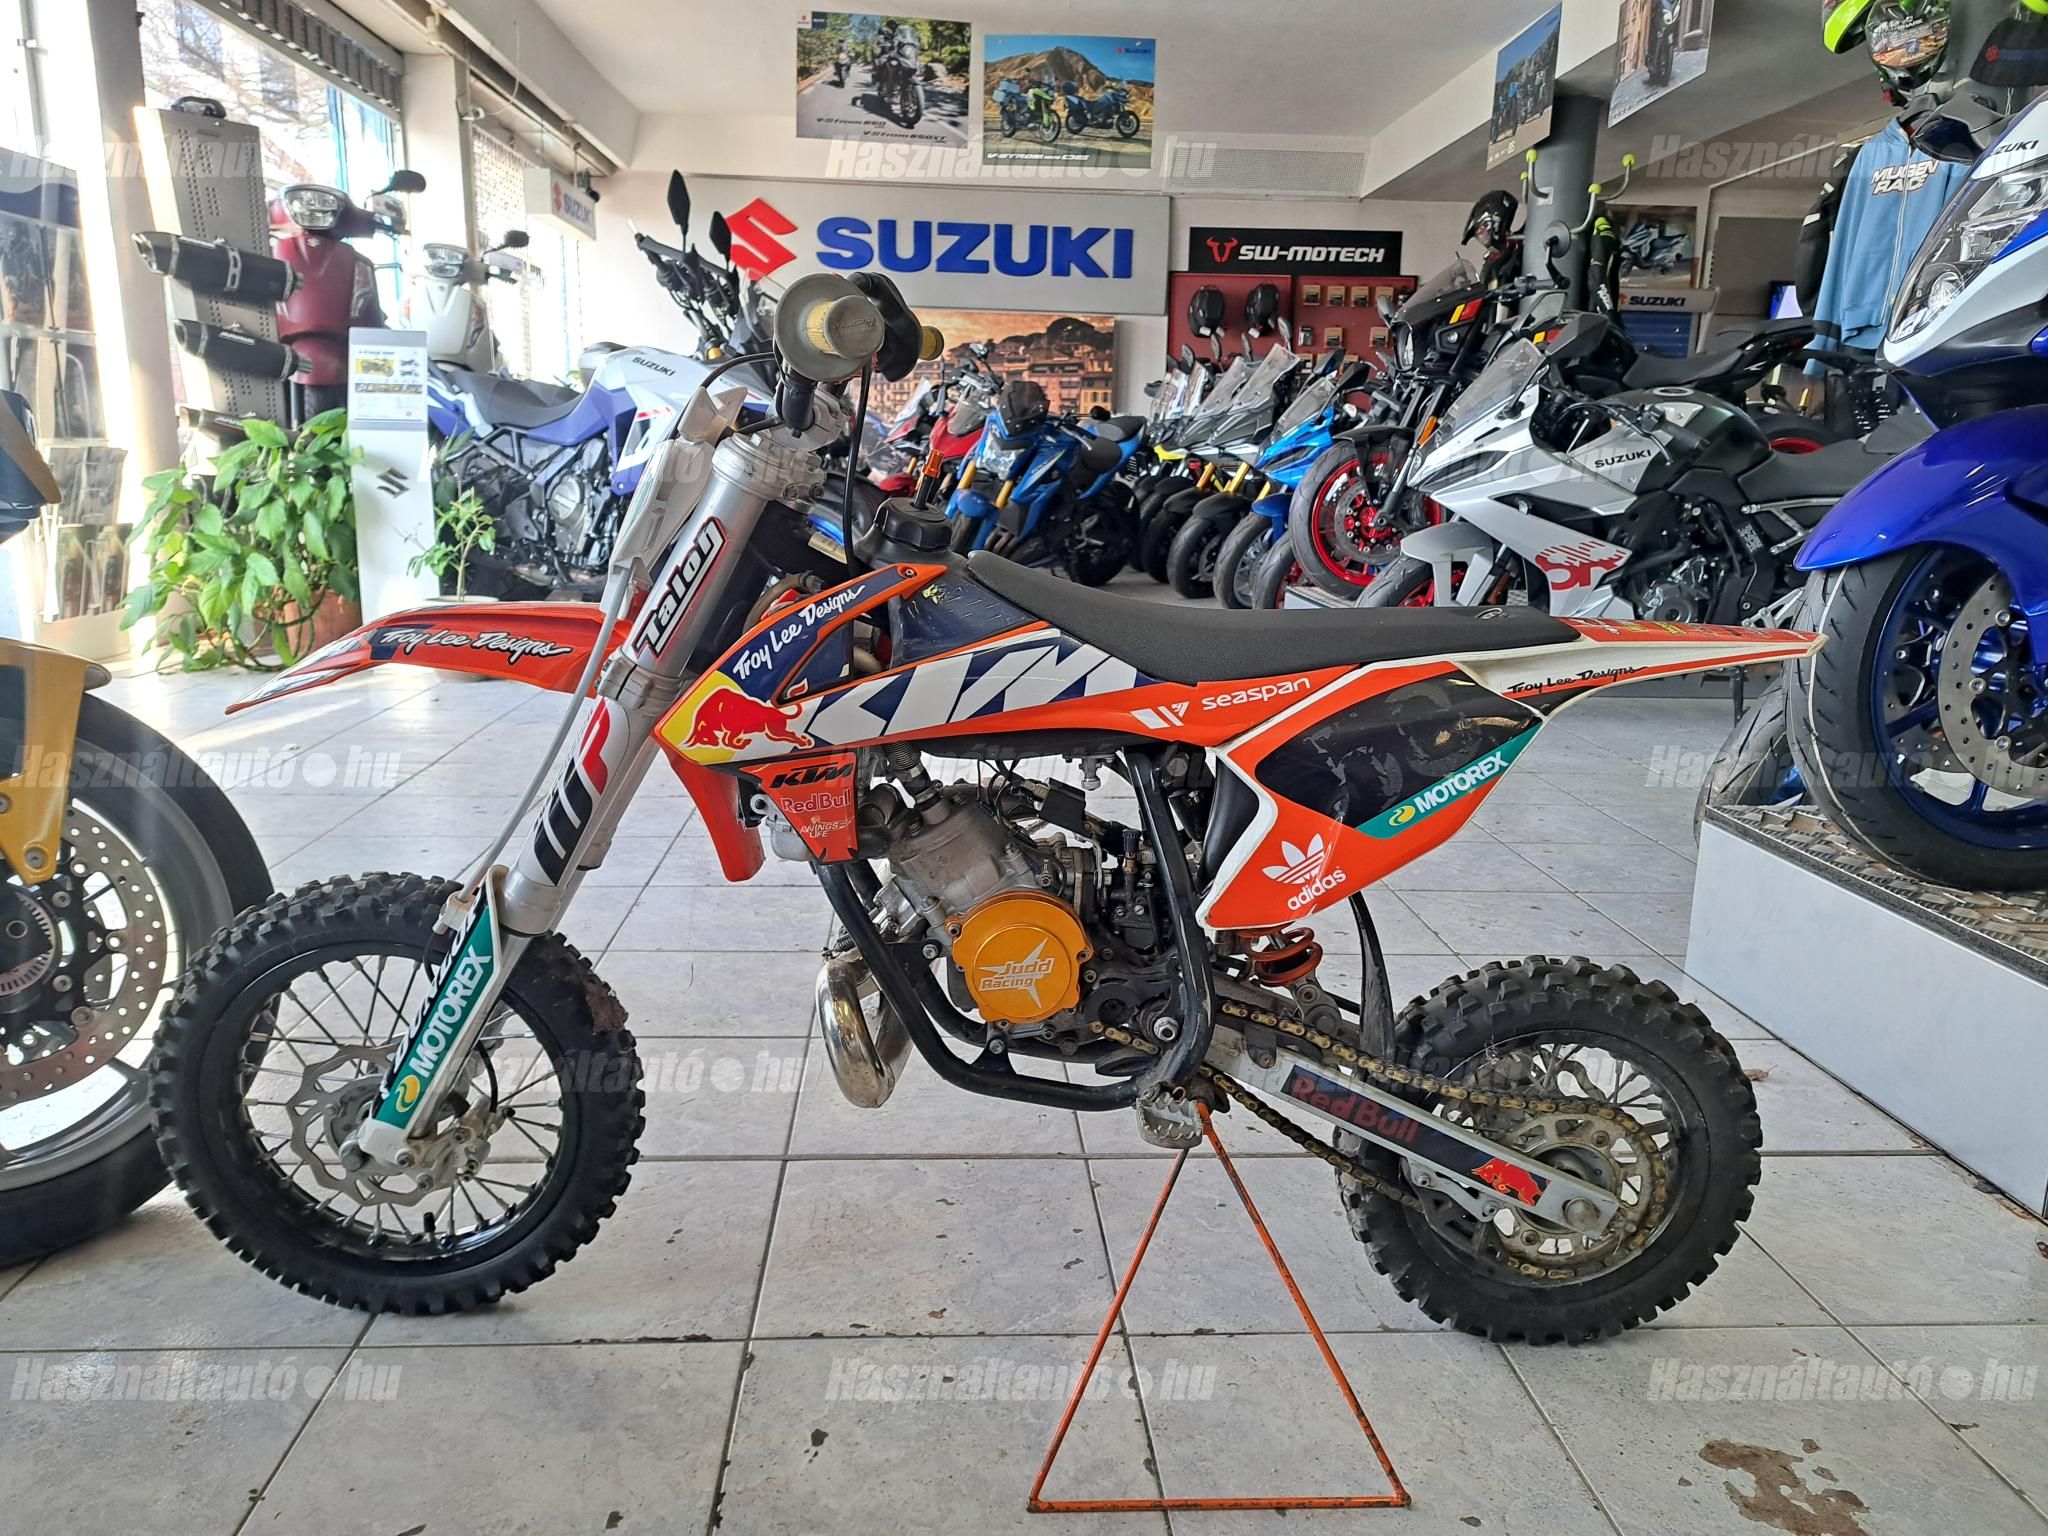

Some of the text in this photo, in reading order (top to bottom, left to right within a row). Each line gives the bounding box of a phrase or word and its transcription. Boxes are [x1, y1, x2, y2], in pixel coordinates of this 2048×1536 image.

[1871, 159, 1940, 185] MUGEN
[1872, 173, 1930, 196] RACE
[563, 193, 592, 226] SUZUKI
[815, 216, 1134, 279] SUZUKI
[1238, 245, 1385, 263] SW-MOTECH
[1629, 295, 1686, 307] SUZUKI
[632, 357, 676, 377] SUZUKI
[1594, 450, 1652, 469] SUZUKI
[637, 518, 725, 654] Talon
[382, 628, 574, 665] Troy Lee Designs
[733, 585, 866, 680] Troy Lee Designs
[806, 628, 1138, 746] KTM
[1201, 677, 1311, 711] seaspan
[1507, 665, 1649, 695] Troy Lee Designs
[769, 762, 854, 789] KTM
[1413, 750, 1509, 814] MOTOREX
[1287, 868, 1348, 911] adidas
[1002, 958, 1055, 976] Judd
[980, 976, 1035, 991] Racing
[408, 945, 493, 1078] MOTOREX
